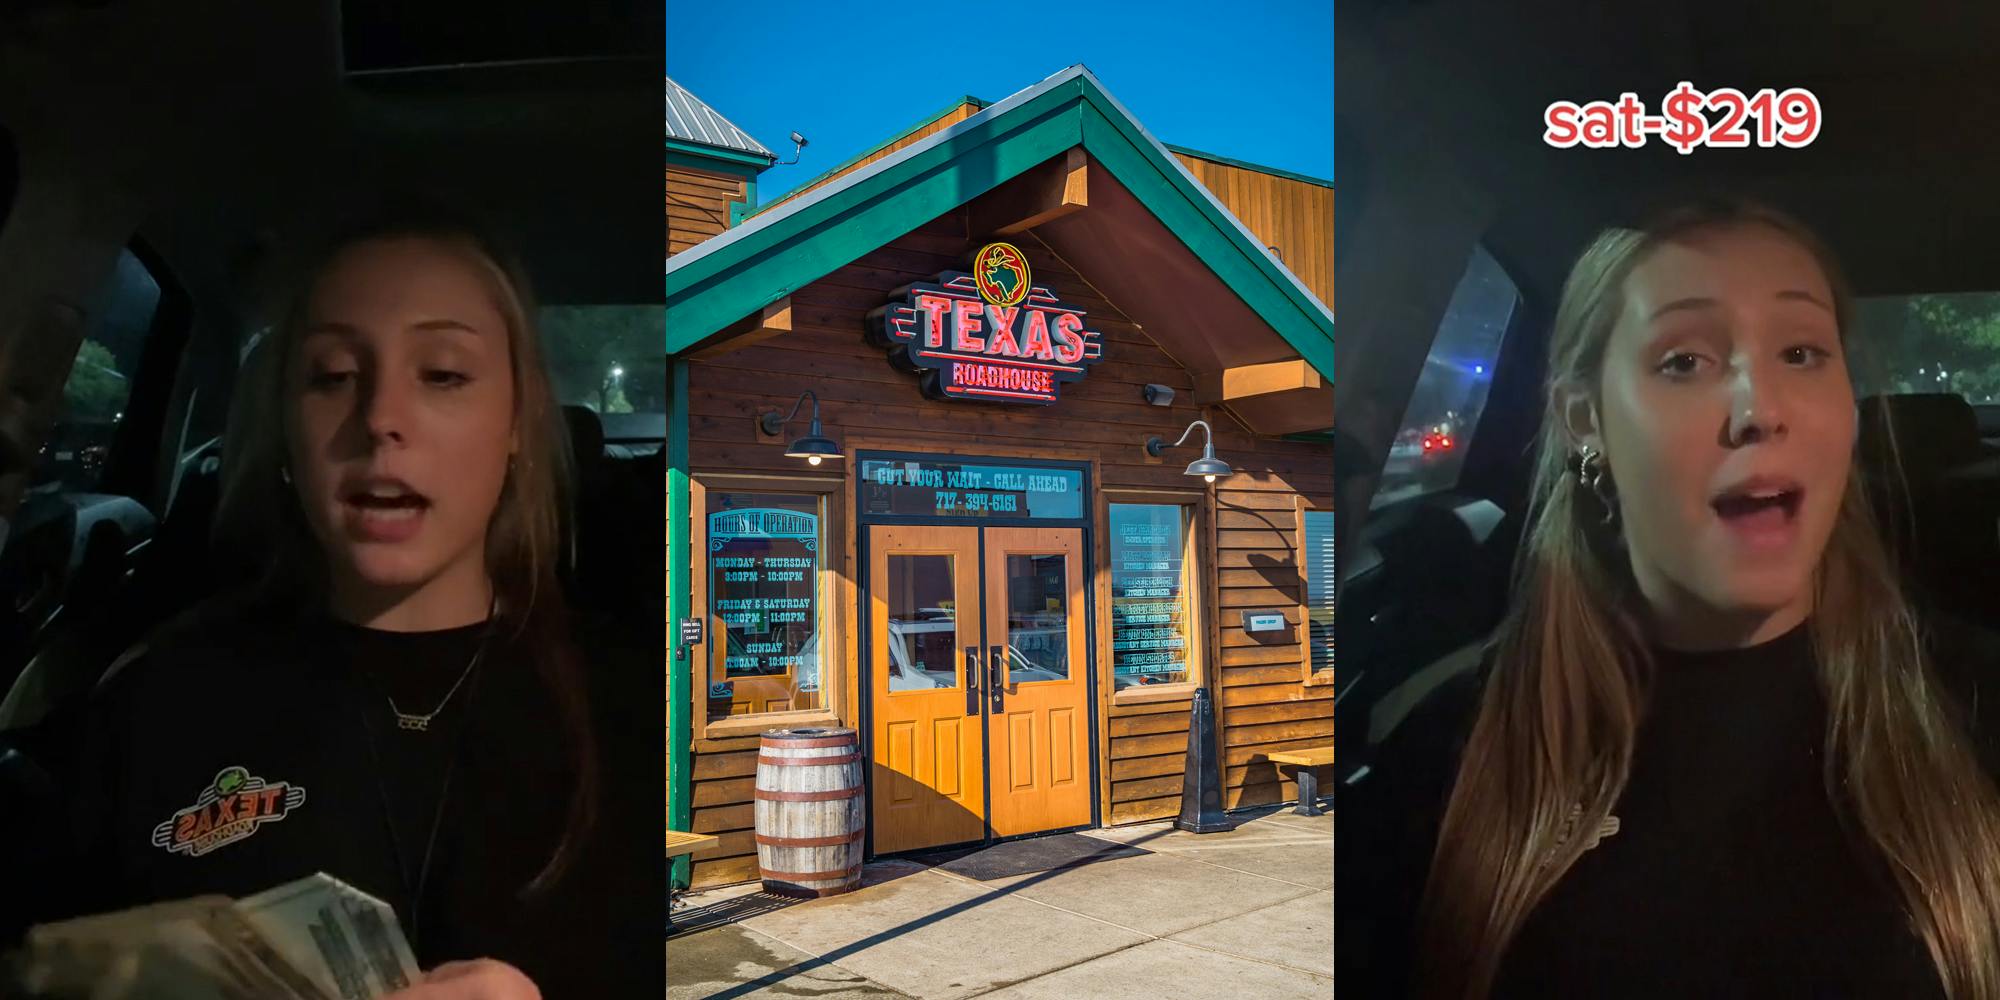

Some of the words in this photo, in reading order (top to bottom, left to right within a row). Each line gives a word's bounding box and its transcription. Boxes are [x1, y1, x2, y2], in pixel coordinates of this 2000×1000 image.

[914, 294, 1086, 364] TEXAS
[952, 362, 1055, 393] ROADHOUSE
[877, 467, 905, 486] CUT
[908, 469, 944, 489] YOUR
[947, 470, 982, 490] WAIT
[993, 473, 1025, 491] CALL
[1028, 474, 1068, 493] AHEAD
[714, 514, 746, 534] HOURS
[748, 512, 762, 534] OF
[763, 512, 814, 534] OPERATION
[715, 557, 756, 568] MONDAY
[763, 557, 812, 568] THURSDAY
[724, 571, 758, 582] 3:00PM
[767, 571, 804, 582] 10:00PM
[717, 599, 752, 610] FRIDAY
[763, 598, 811, 609] SATURDAY
[723, 612, 760, 623] 12:00PM
[770, 612, 806, 622] 11:00PM
[746, 642, 784, 653] SUNDAY
[768, 656, 804, 667] 10:00PM
